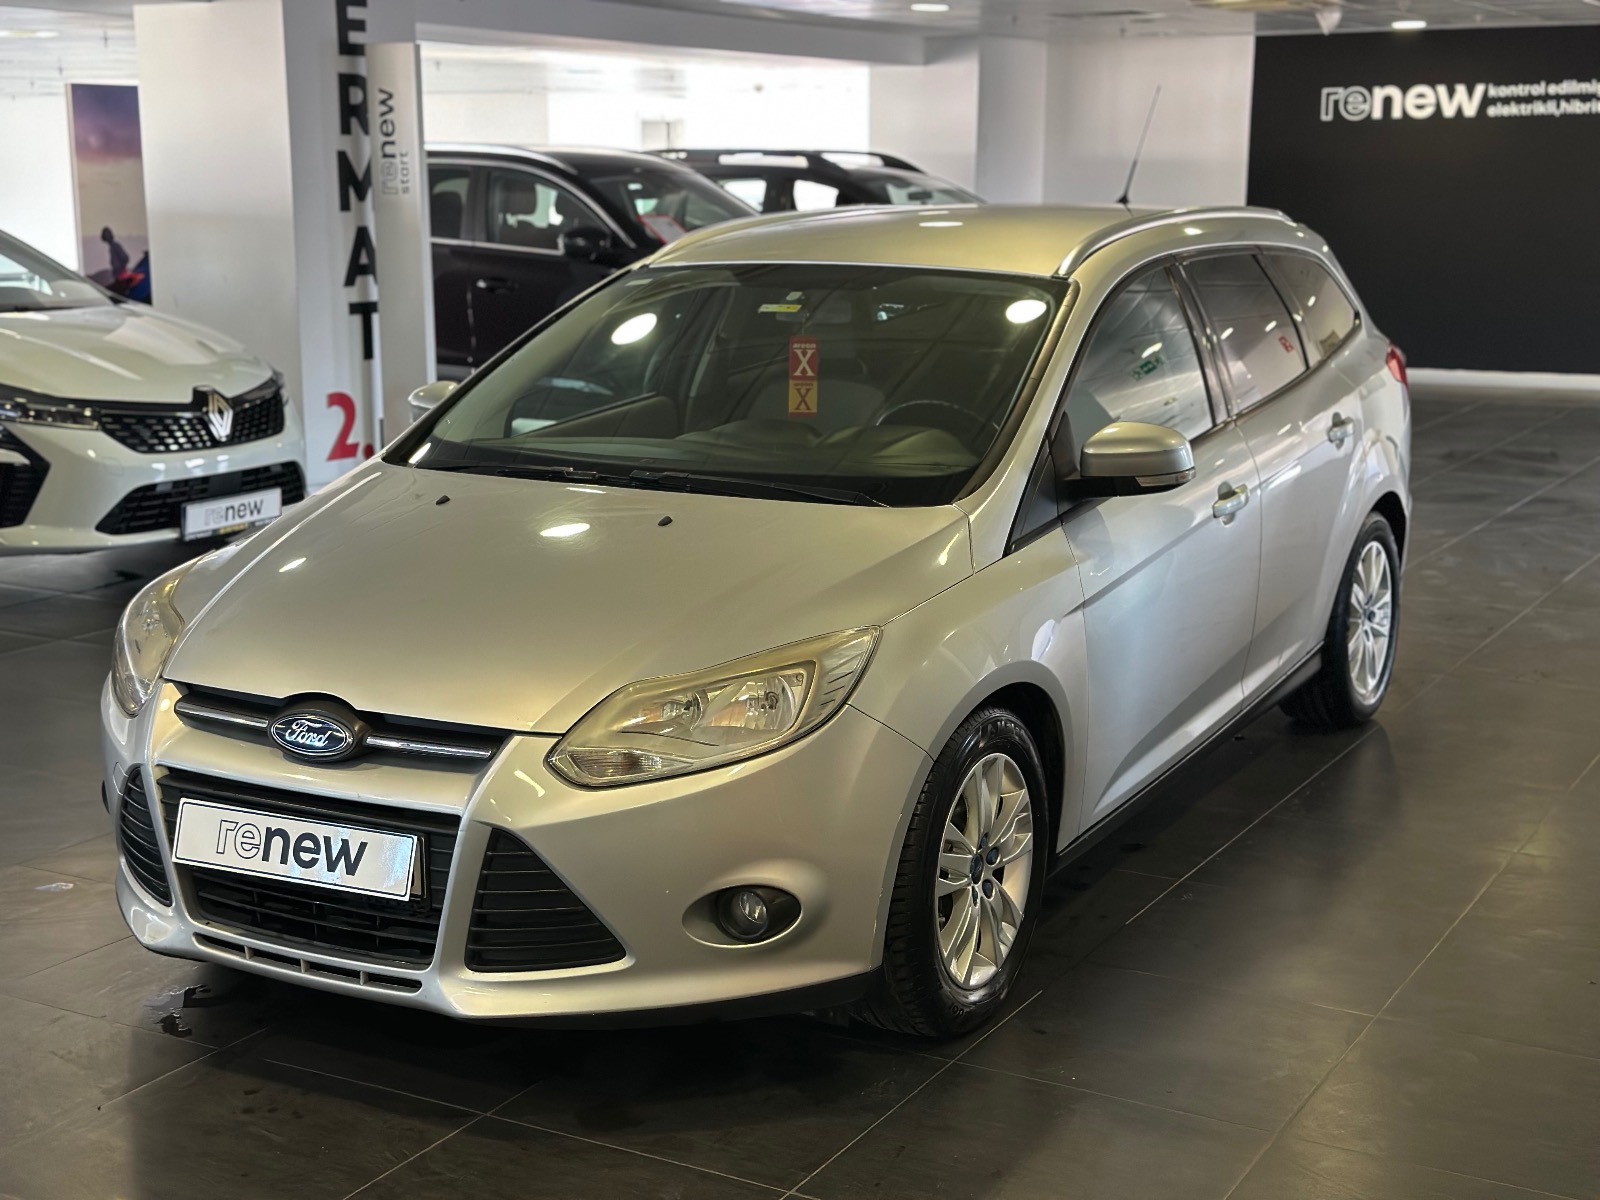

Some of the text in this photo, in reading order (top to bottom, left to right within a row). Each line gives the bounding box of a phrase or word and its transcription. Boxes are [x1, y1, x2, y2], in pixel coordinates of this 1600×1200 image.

[1320, 83, 1486, 122] renew
[1487, 81, 1546, 98] kontrol
[377, 87, 398, 195] renew
[401, 151, 410, 194] start
[792, 349, 816, 376] X
[794, 387, 813, 410] X
[204, 498, 264, 526] renew
[285, 718, 330, 748] Ford
[216, 819, 368, 876] renew
